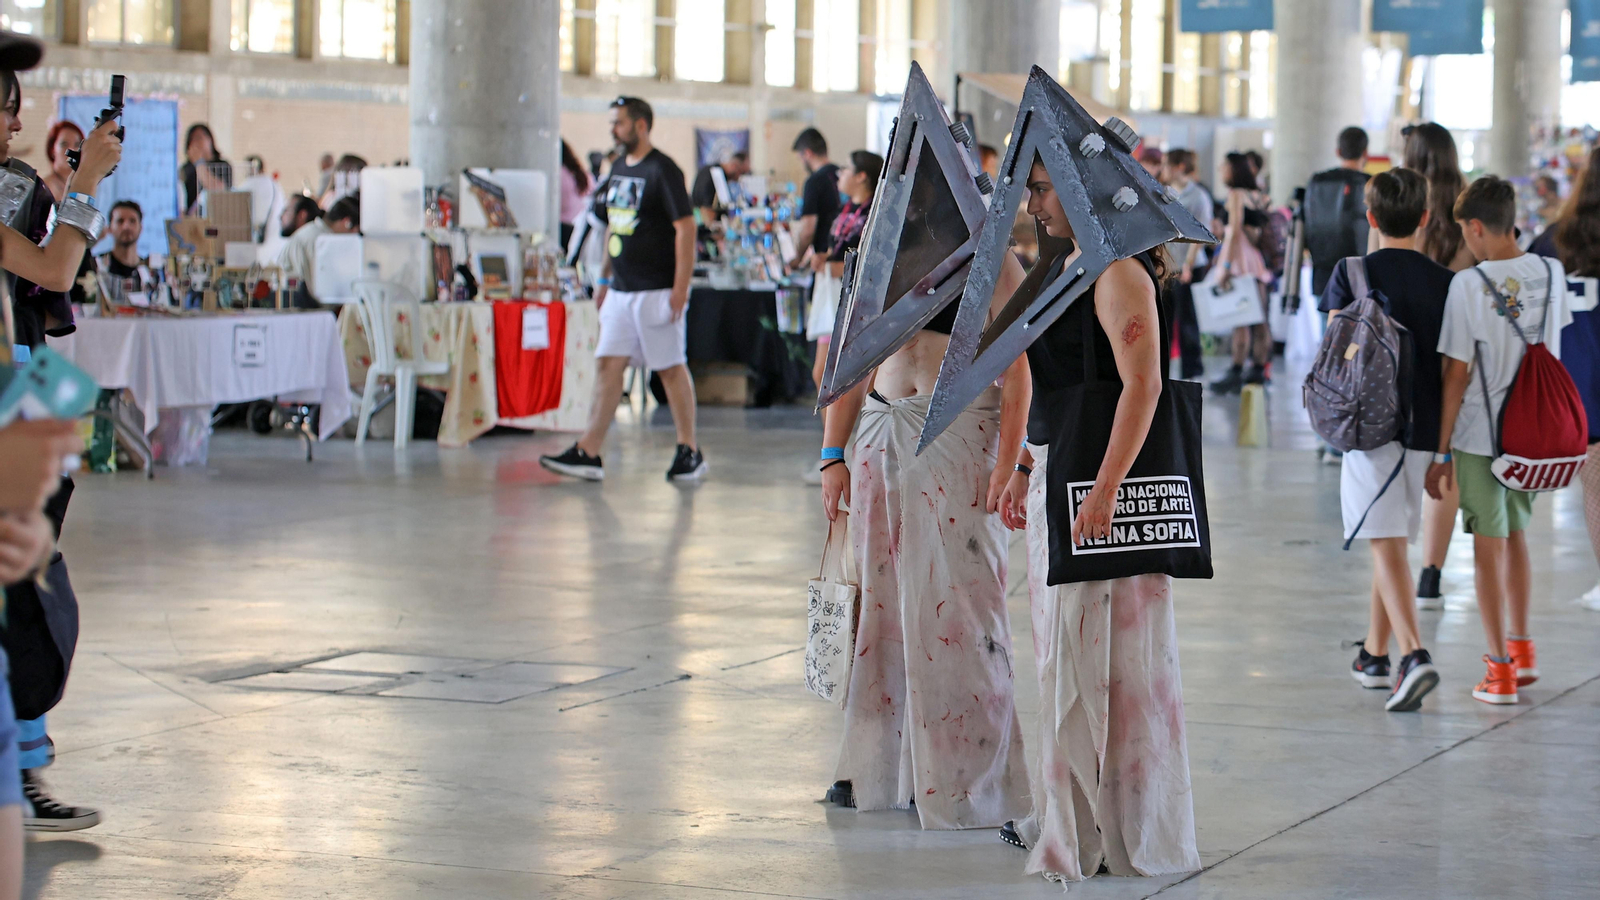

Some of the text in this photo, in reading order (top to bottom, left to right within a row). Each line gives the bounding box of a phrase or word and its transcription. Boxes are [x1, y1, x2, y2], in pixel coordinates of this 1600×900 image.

[1127, 483, 1188, 499] NACIONAL
[1138, 499, 1158, 513] DE
[1160, 498, 1191, 512] ARTE
[1142, 522, 1195, 542] SOFIA
